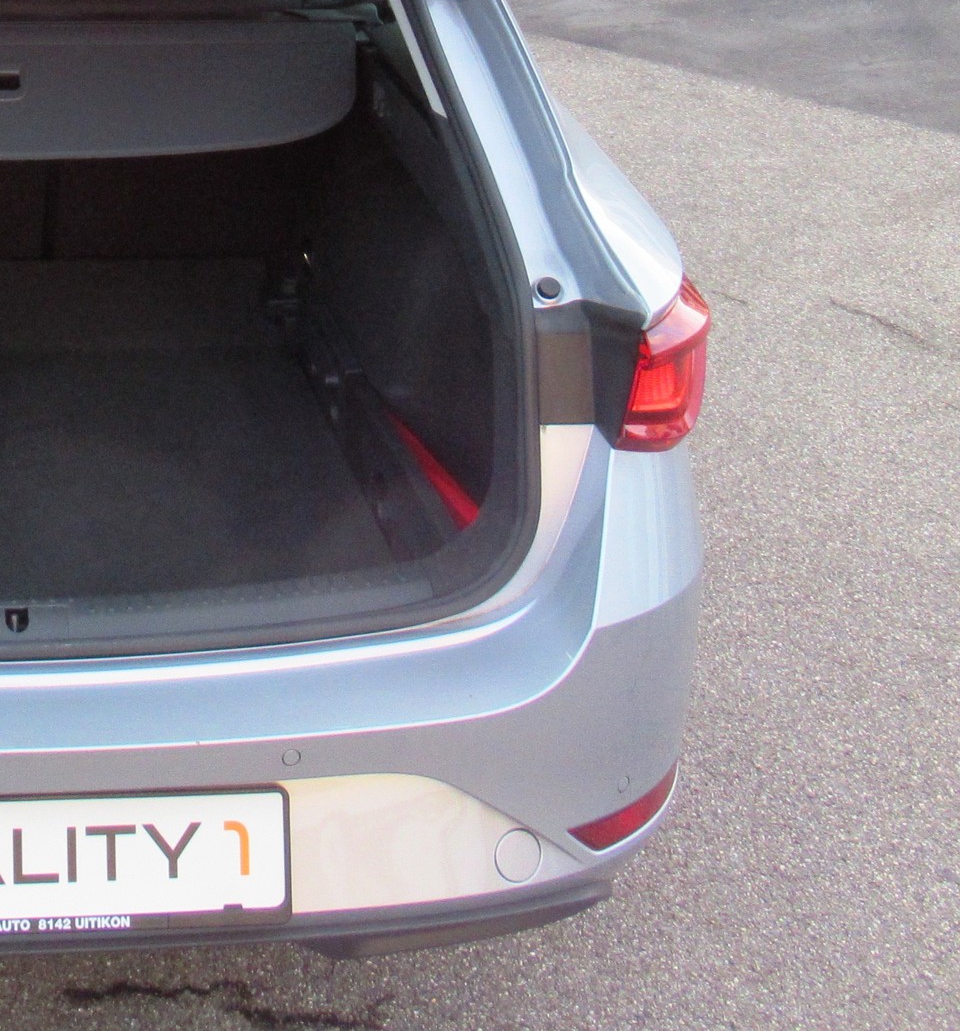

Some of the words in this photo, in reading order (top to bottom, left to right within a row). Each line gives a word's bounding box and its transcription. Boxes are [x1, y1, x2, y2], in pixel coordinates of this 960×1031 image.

[224, 821, 250, 876] 1
[38, 918, 72, 930] 8142
[75, 916, 131, 930] UITIKON
